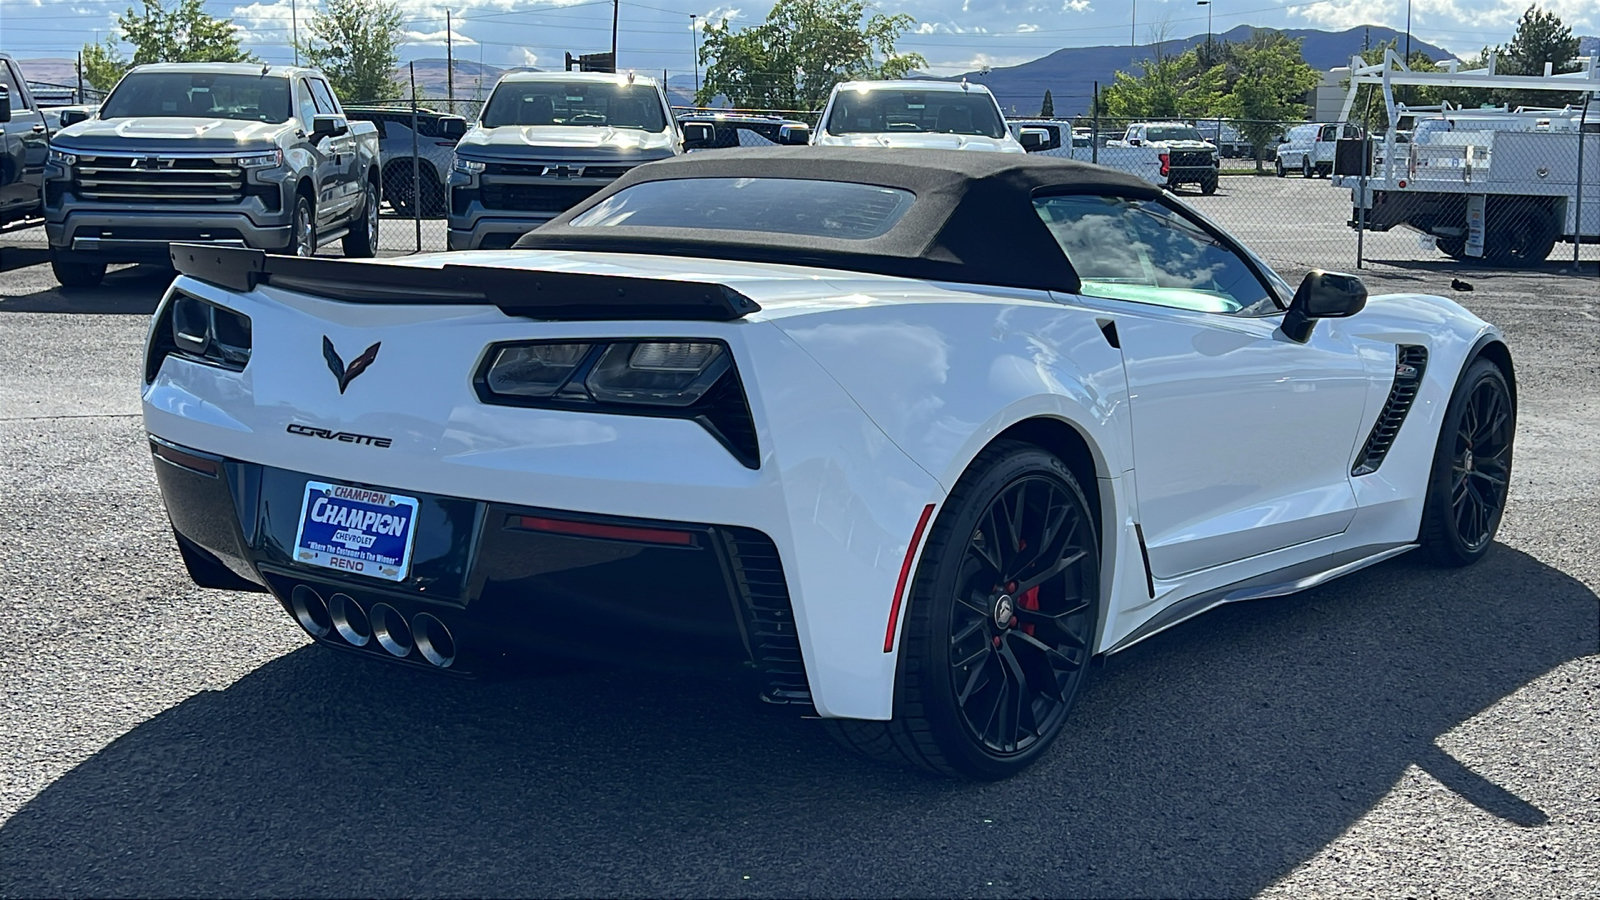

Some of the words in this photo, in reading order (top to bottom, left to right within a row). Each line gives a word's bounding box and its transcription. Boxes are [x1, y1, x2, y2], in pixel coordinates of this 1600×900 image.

[287, 424, 392, 448] CORVETTE
[334, 487, 386, 504] CHAMPION
[311, 497, 407, 537] CHAMPION
[335, 531, 373, 545] CHEVROLET
[327, 544, 335, 553] The
[336, 546, 360, 557] Customer
[360, 551, 366, 559] Is
[366, 552, 376, 561] The
[330, 557, 364, 571] RENO
